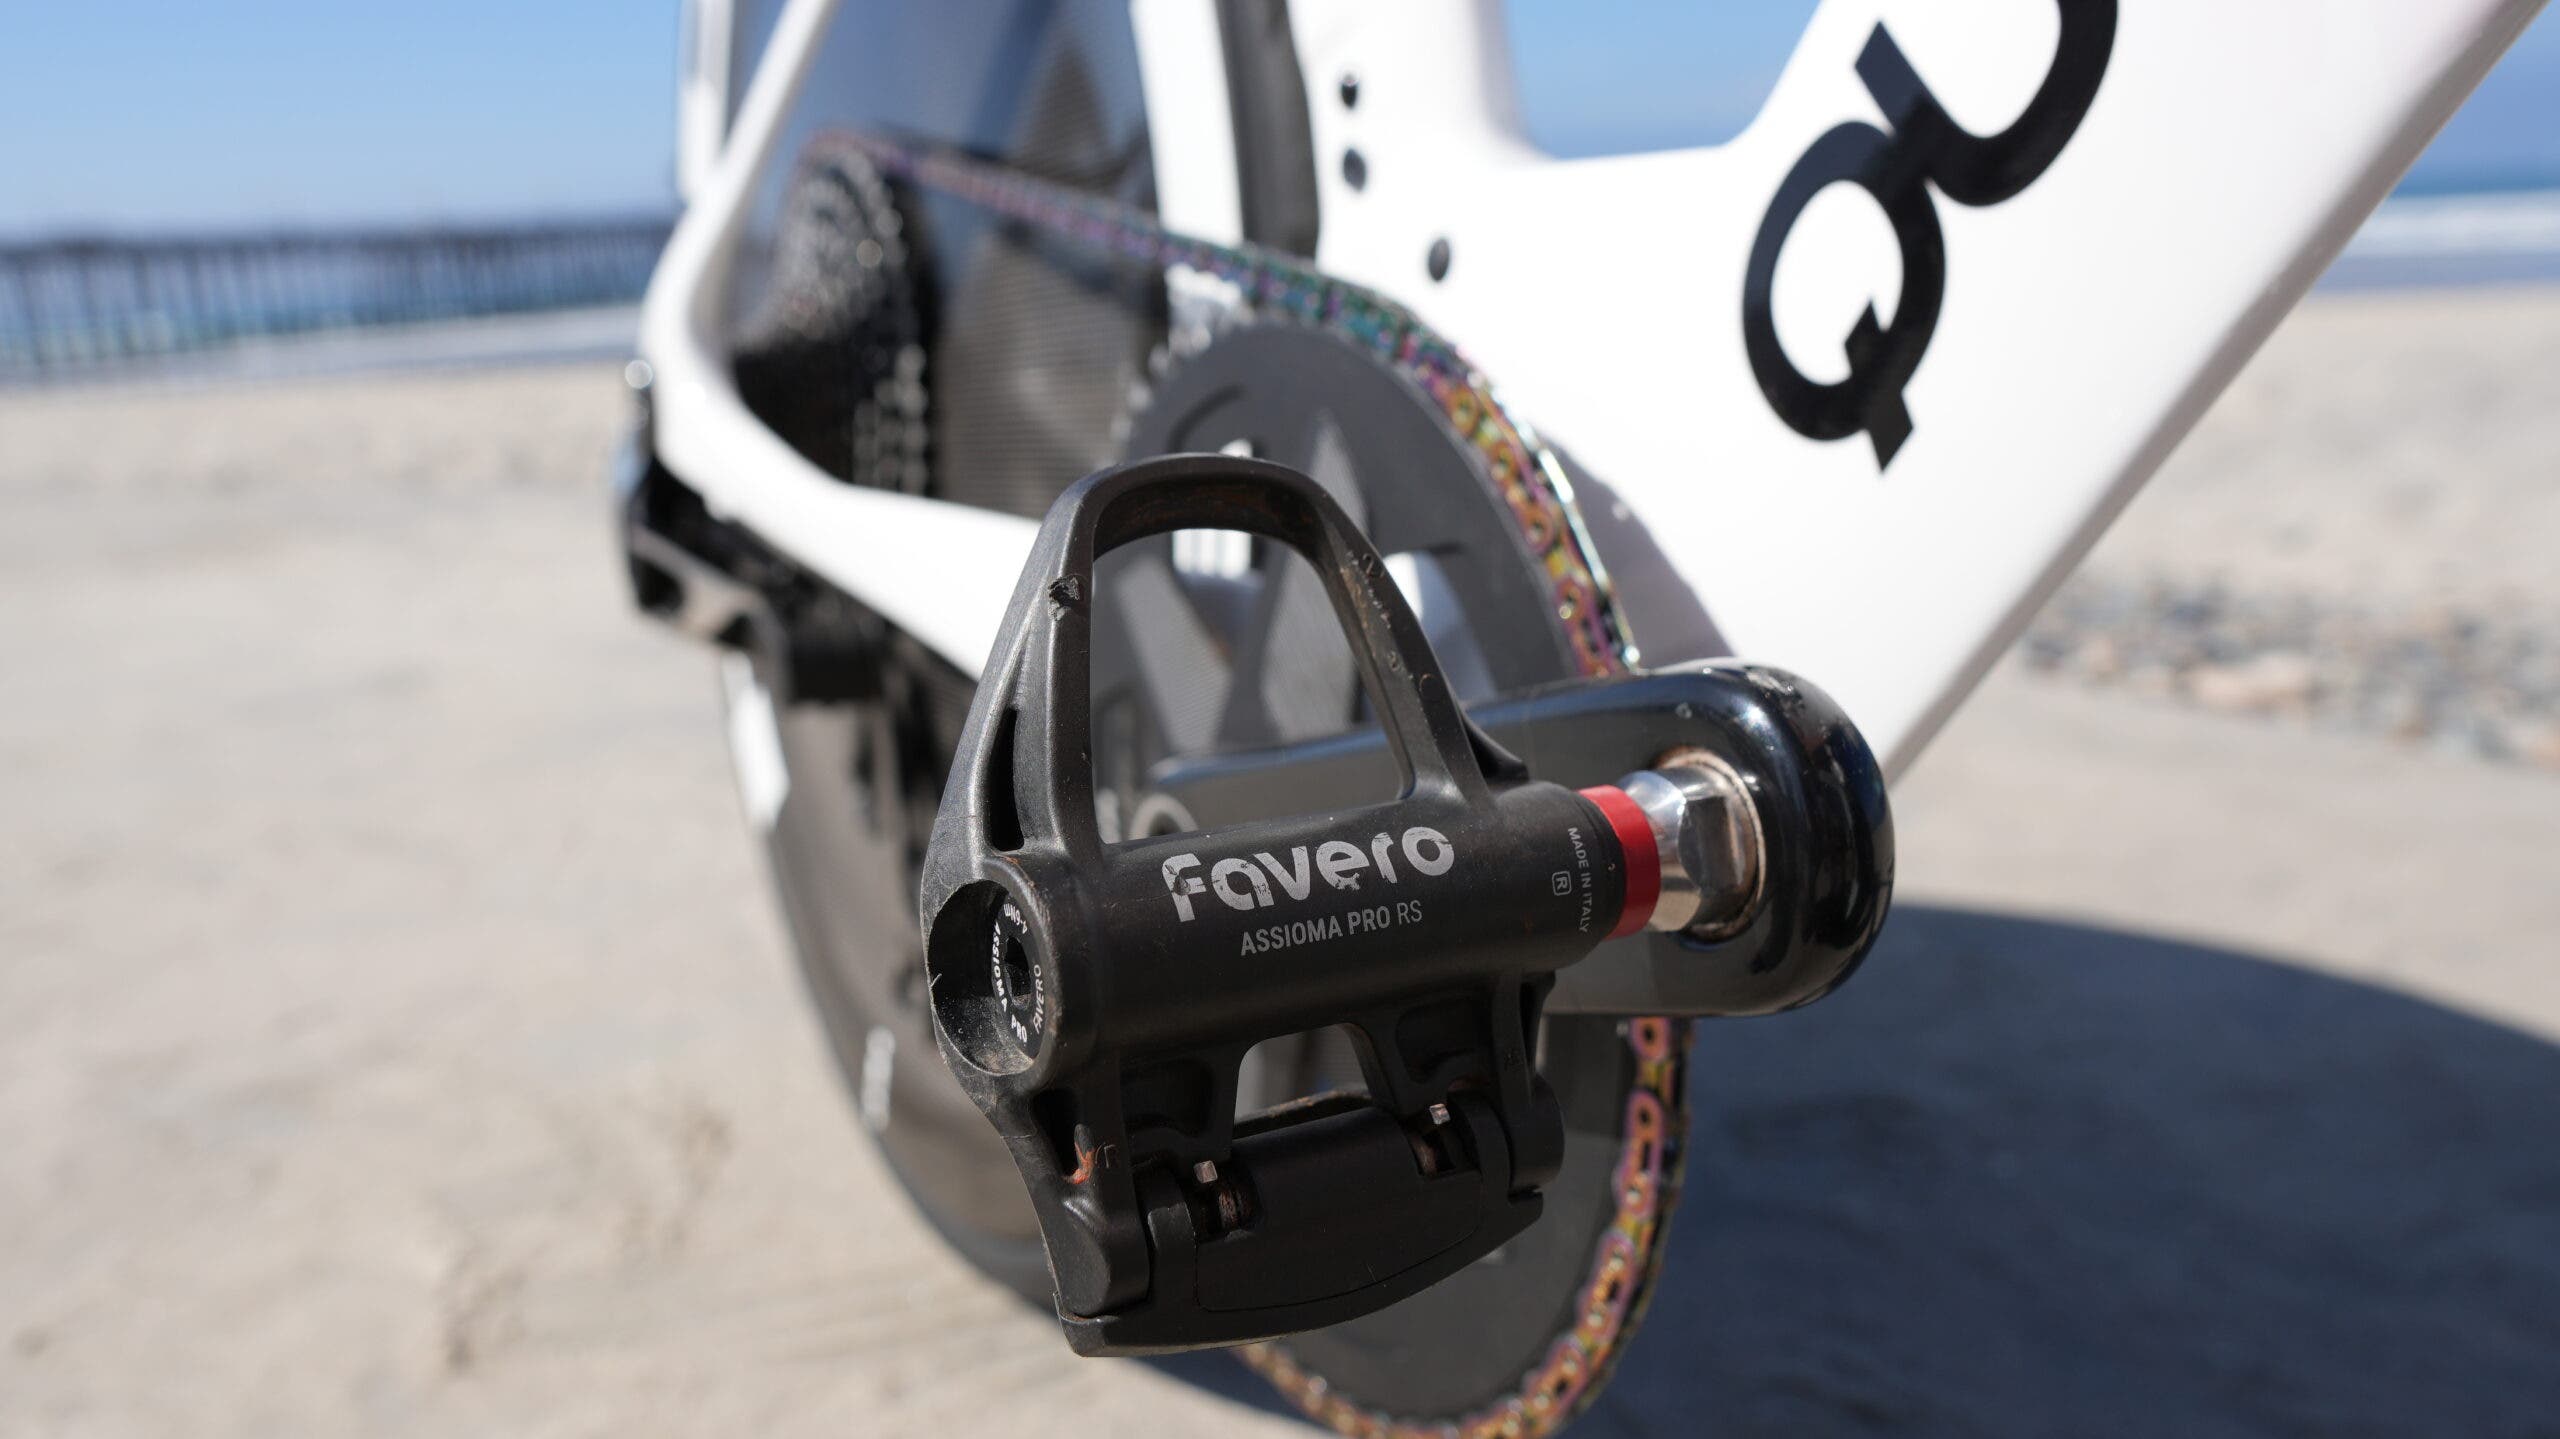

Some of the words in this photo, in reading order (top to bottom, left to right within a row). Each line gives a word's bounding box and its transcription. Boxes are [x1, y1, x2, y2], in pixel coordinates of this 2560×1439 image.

[1162, 826, 1454, 922] Favero
[1567, 827, 1589, 868] MADE
[1581, 872, 1591, 888] IN
[1240, 915, 1343, 956] ASSIOMA
[1347, 905, 1391, 935] PRO
[1396, 900, 1423, 925] RS
[1579, 893, 1592, 932] ITALY
[992, 921, 1008, 1012] ASSIOMA
[1011, 1014, 1028, 1043] PRO
[1032, 964, 1044, 1034] FAVERO
